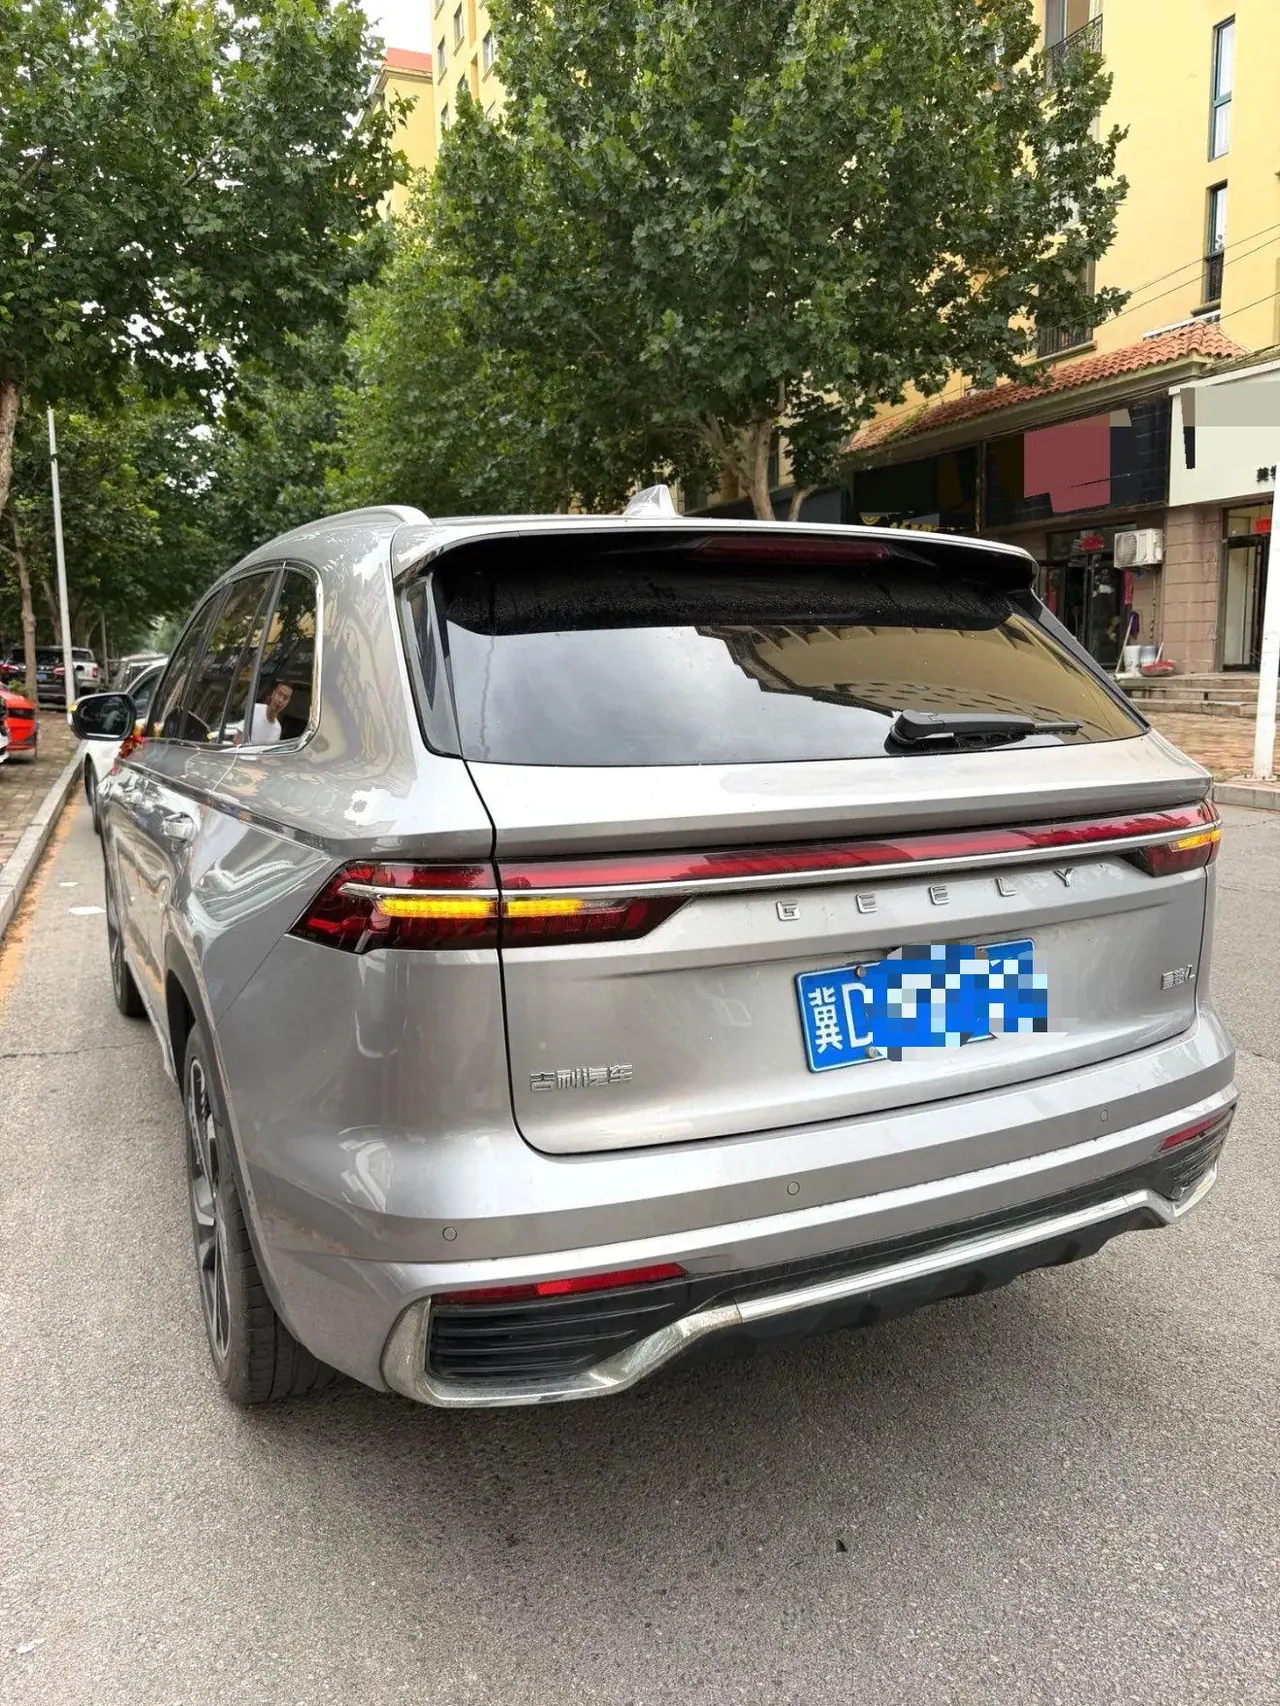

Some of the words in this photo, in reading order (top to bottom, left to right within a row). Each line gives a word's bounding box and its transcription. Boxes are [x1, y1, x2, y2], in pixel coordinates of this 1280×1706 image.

[776, 868, 1074, 921] GEELY
[530, 1064, 633, 1091] 吉利汽车
